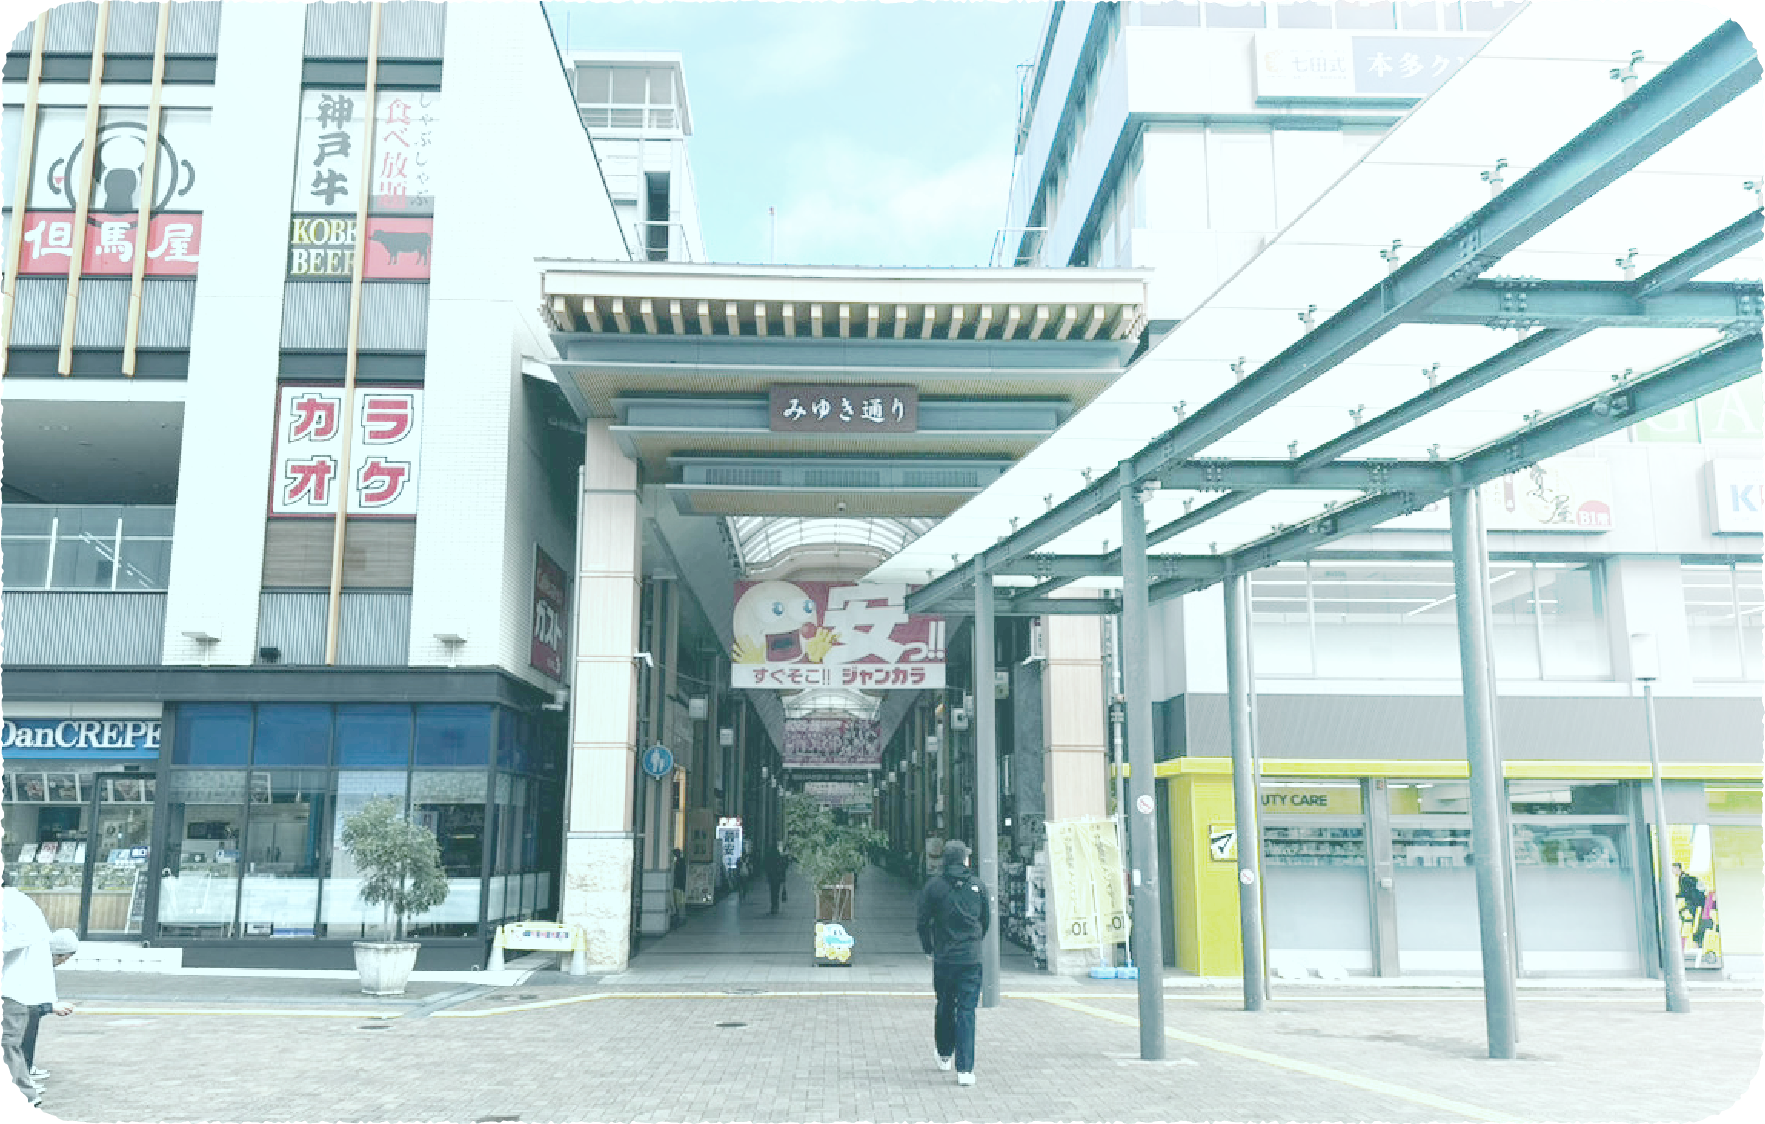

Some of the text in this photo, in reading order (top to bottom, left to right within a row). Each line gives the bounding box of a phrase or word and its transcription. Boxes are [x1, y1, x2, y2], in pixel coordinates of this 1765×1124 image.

[1291, 55, 1347, 73] 七田式
[1366, 51, 1465, 78] 本多ク
[311, 92, 355, 206] 神戸牛
[377, 98, 412, 209] 食べ放題
[24, 220, 200, 262] 但馬屋
[783, 397, 905, 423] みゆき通り
[842, 667, 926, 686] ジャンカラ
[1290, 794, 1328, 808] CARE
